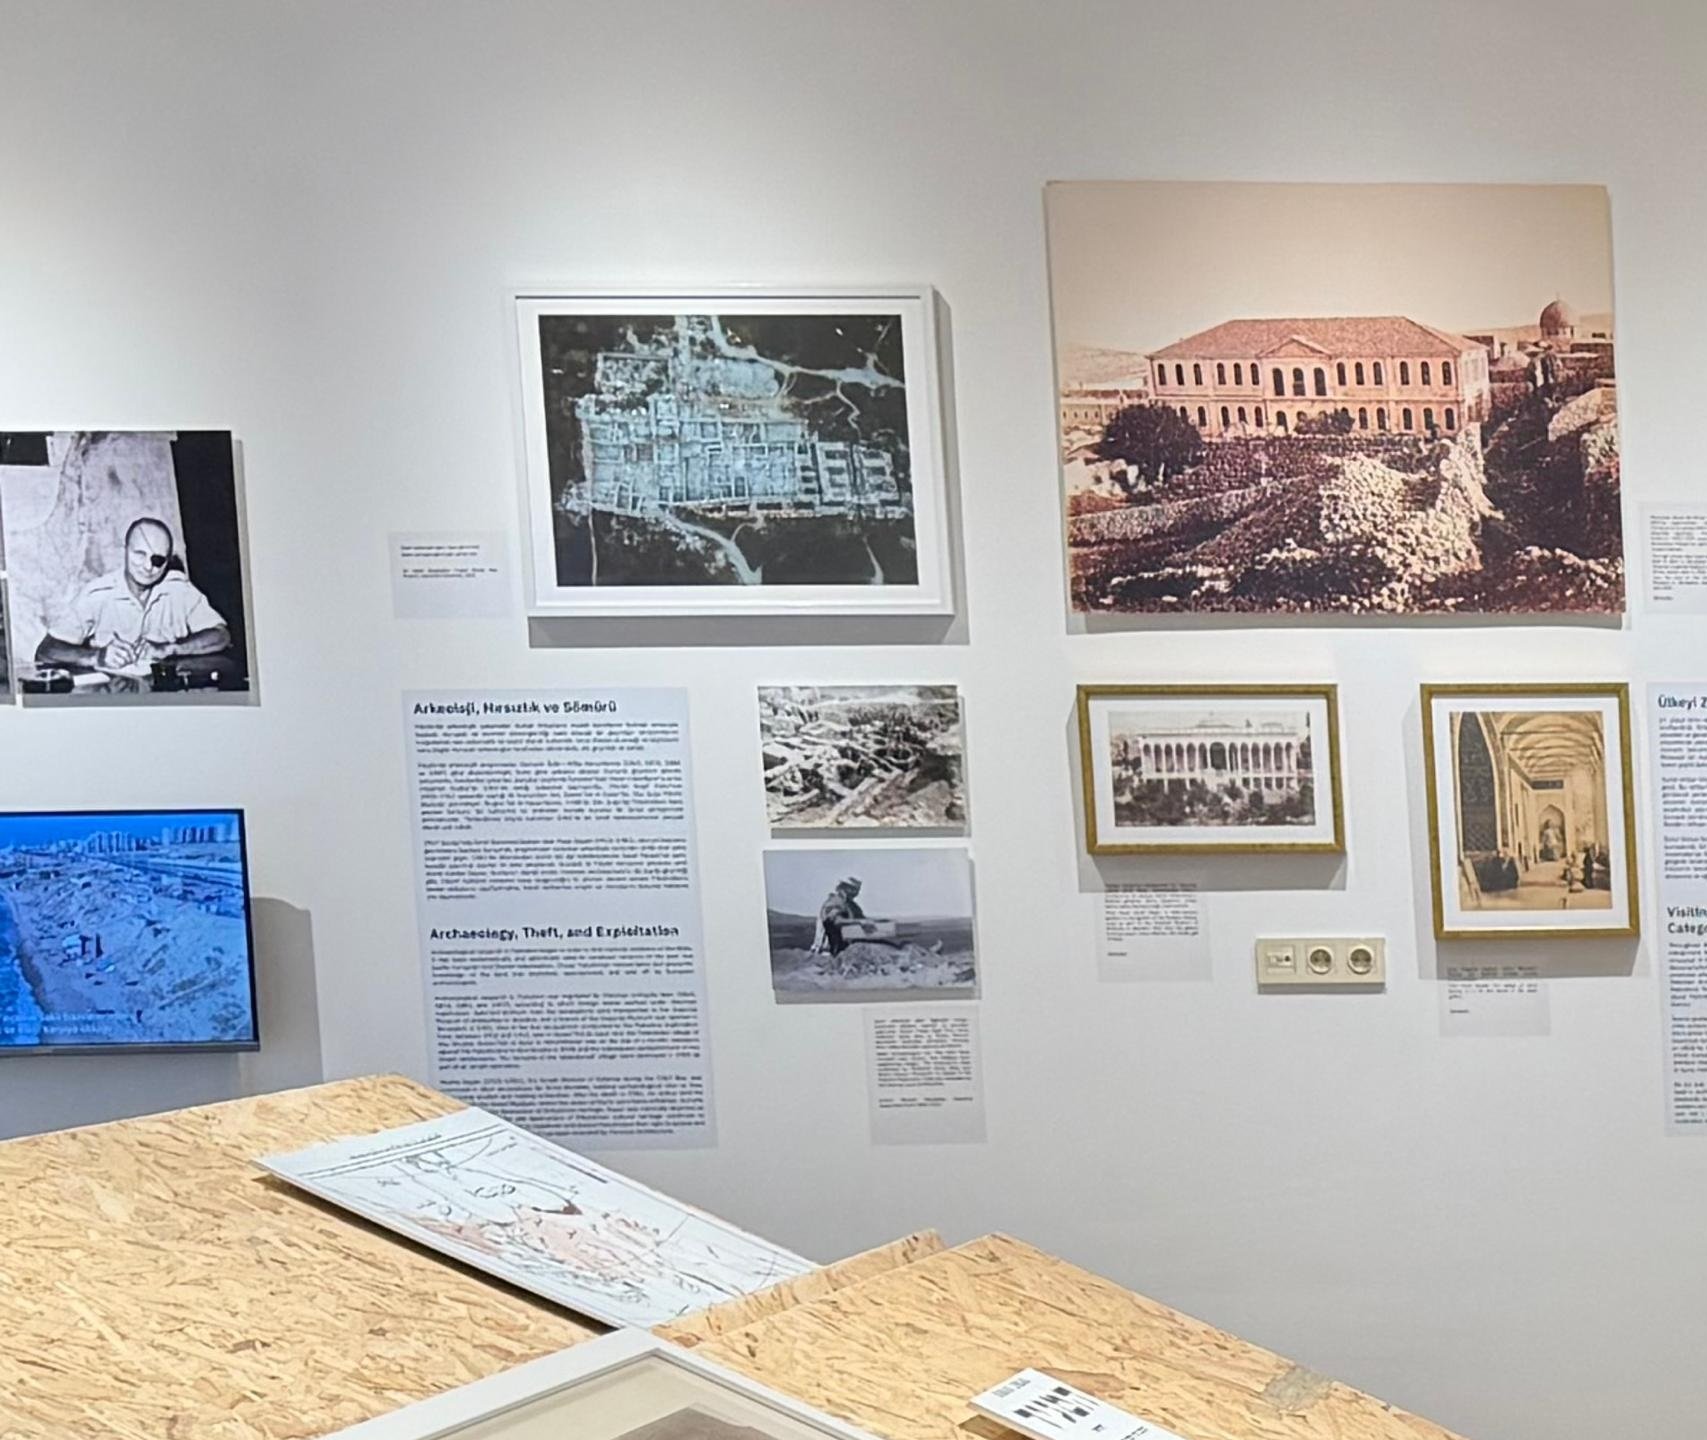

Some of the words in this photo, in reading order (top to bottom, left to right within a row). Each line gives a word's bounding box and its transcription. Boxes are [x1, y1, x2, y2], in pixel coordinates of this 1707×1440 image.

[544, 705, 559, 714] ve
[563, 700, 617, 714] Sömürü
[1658, 694, 1697, 710] Ülkeyi
[430, 928, 518, 941] Archaeology,
[522, 927, 563, 939] Theft,
[567, 926, 592, 938] and
[596, 925, 680, 938] Exploitation
